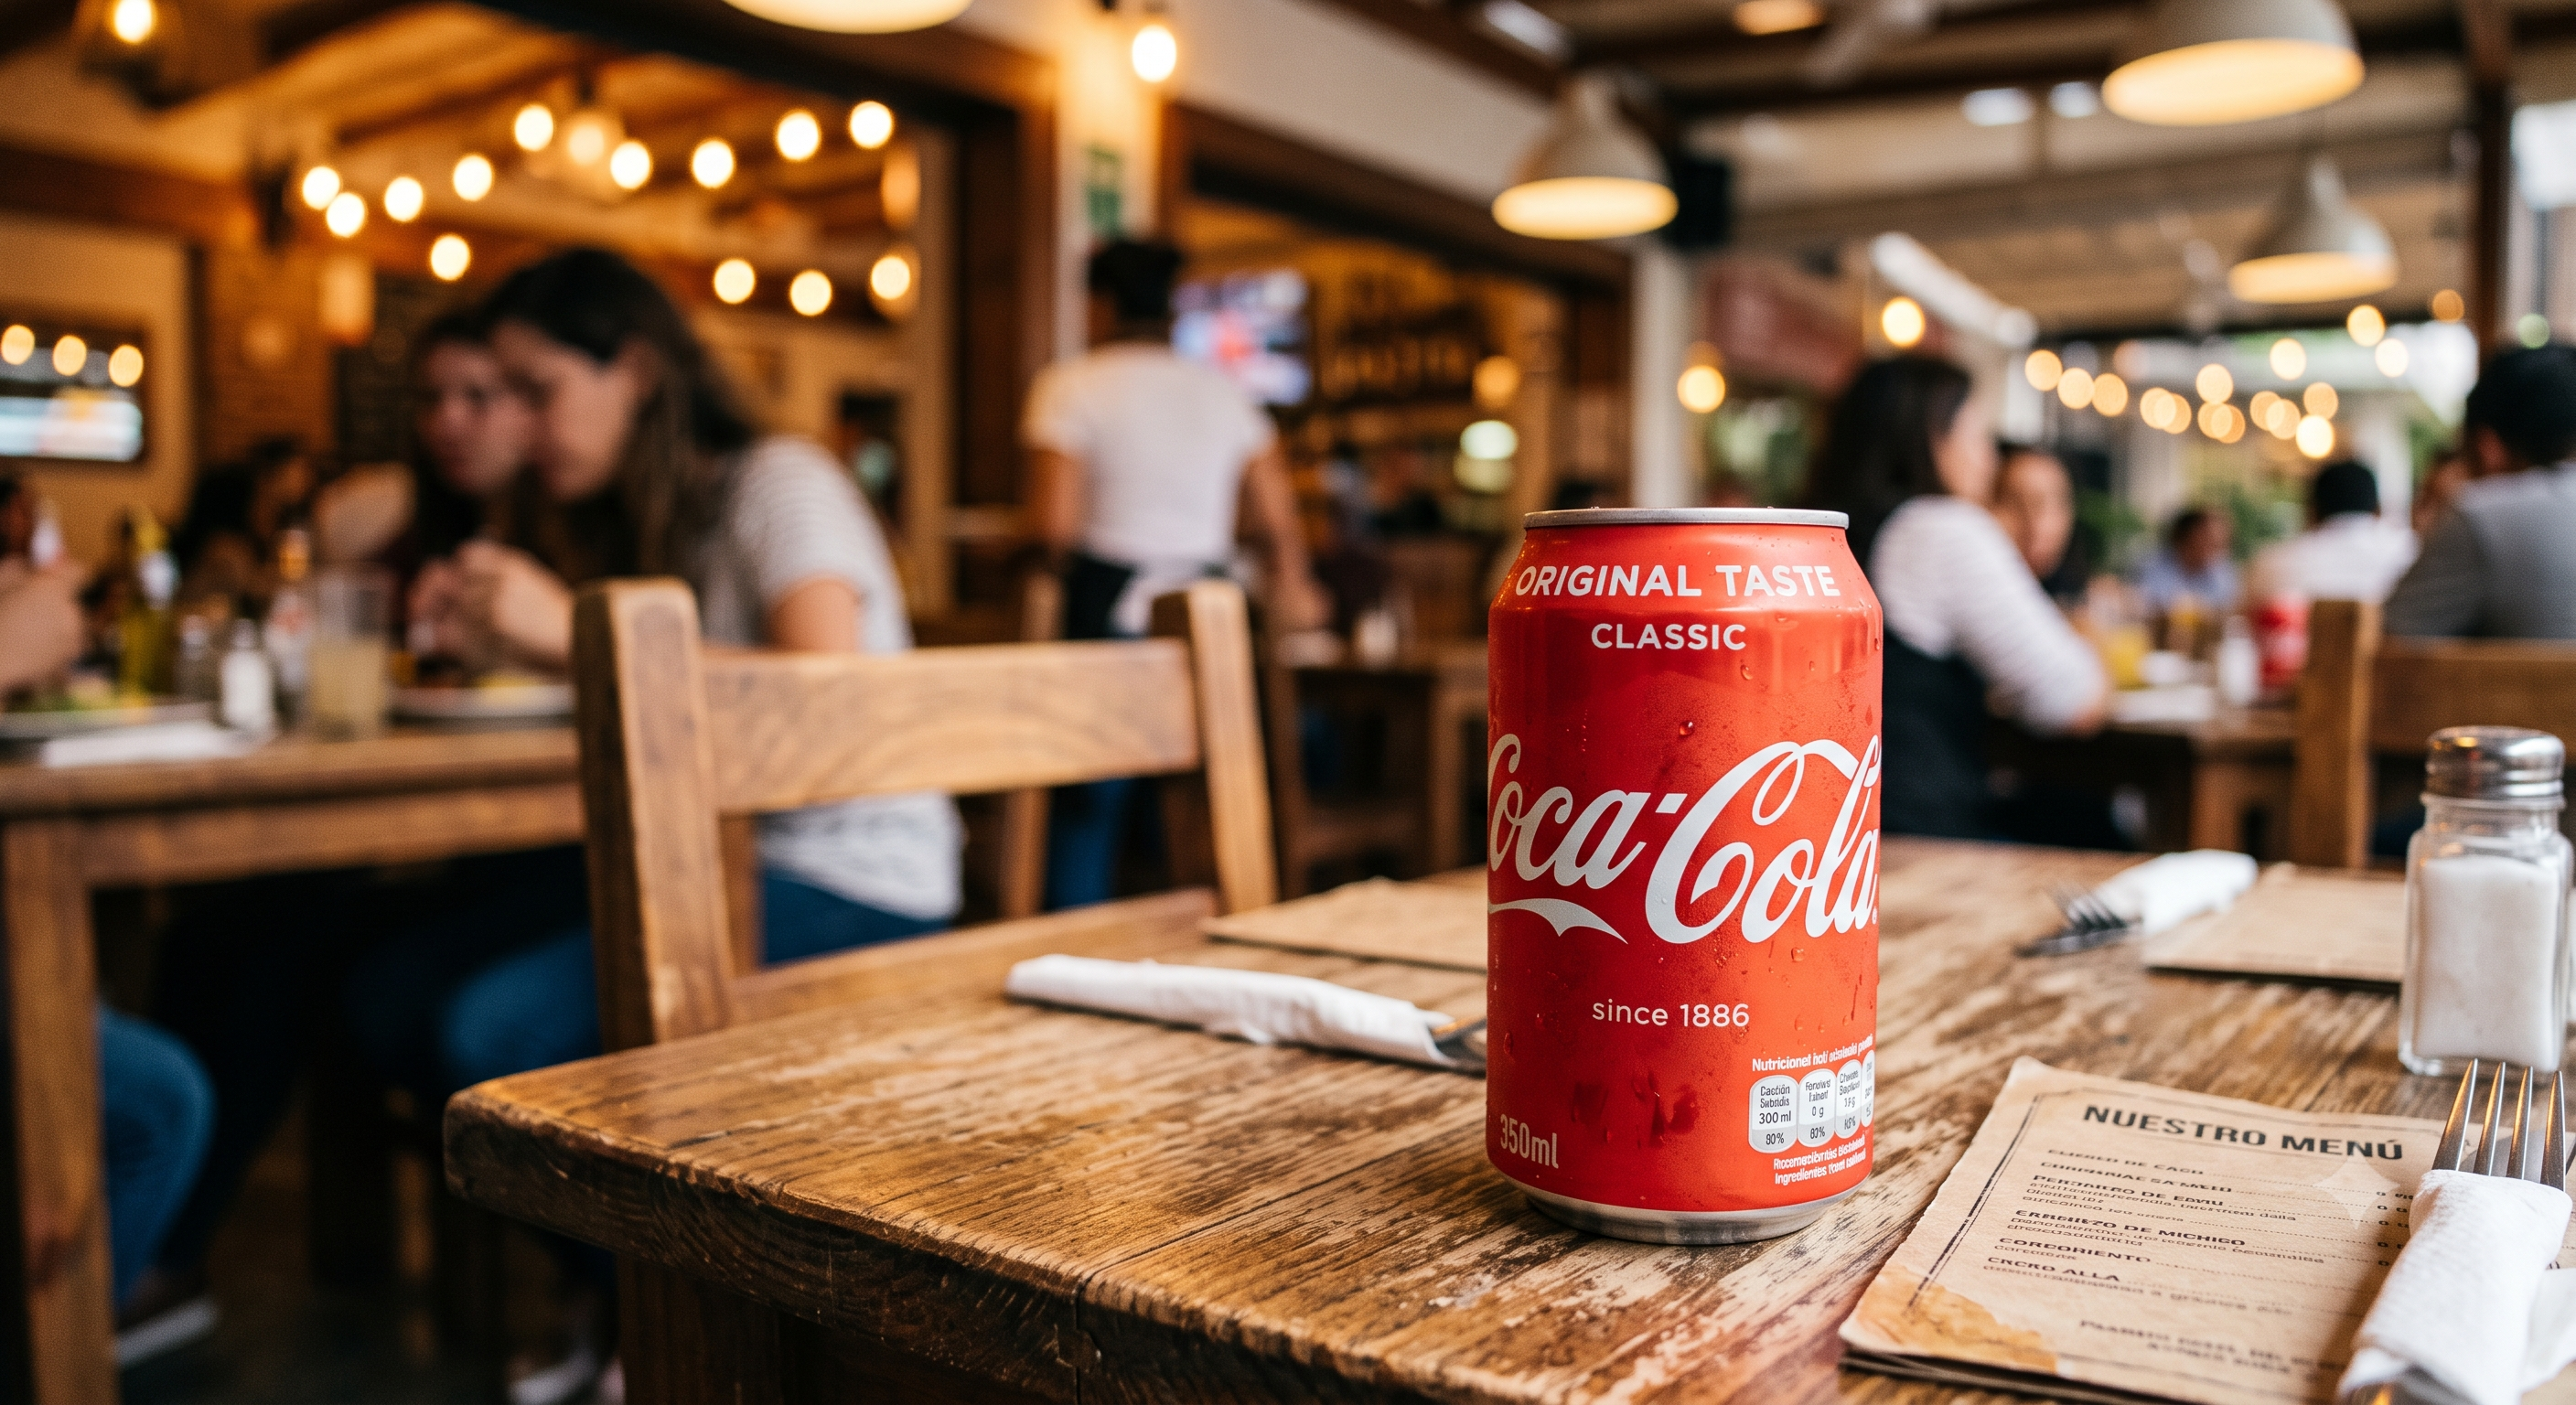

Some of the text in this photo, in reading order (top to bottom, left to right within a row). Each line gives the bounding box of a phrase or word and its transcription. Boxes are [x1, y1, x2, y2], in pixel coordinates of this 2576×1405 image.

[1515, 564, 1841, 597] ORIGINAL TASTE
[1591, 622, 1746, 650] CLASSIC
[1592, 998, 1750, 1027] since 1886
[1759, 1110, 1791, 1124] 300 ml
[2083, 1104, 2403, 1160] NUESTRO MENÚ
[1500, 1113, 1559, 1169] 350ml
